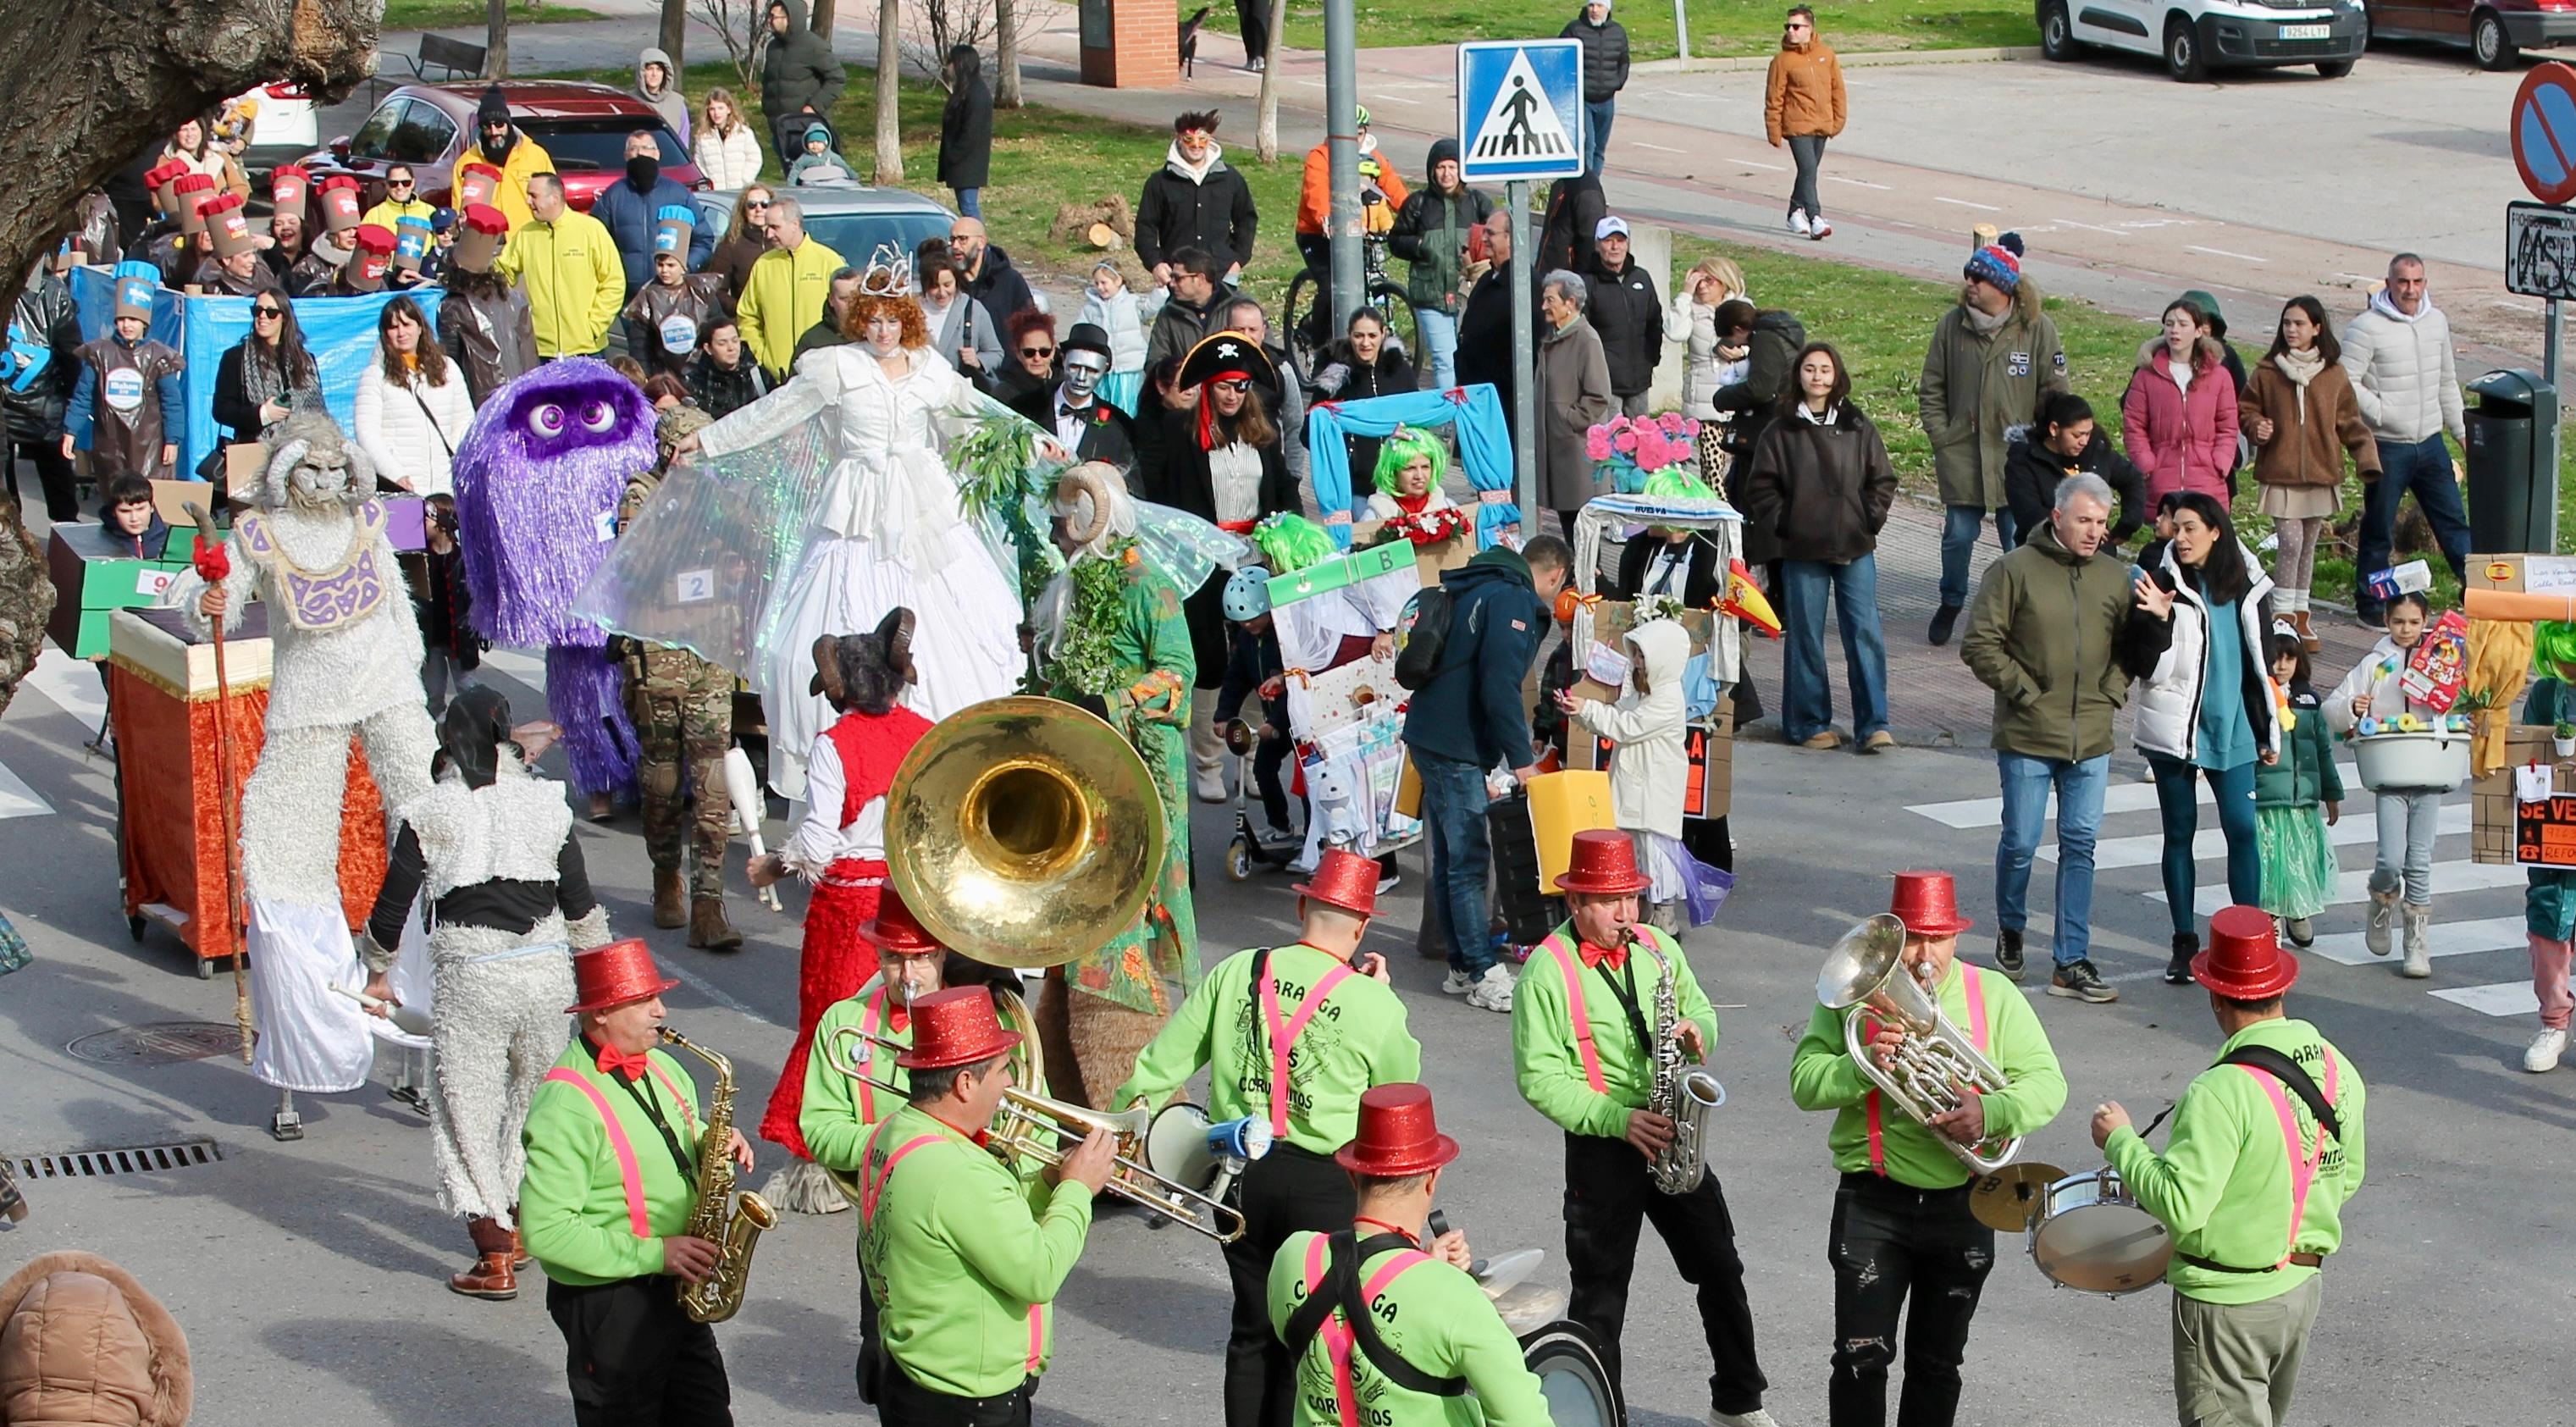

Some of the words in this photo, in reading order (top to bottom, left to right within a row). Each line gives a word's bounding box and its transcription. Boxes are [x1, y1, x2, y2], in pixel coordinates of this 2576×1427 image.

[2286, 26, 2308, 37] 9254
[2310, 26, 2328, 36] LYY
[1634, 506, 1667, 515] HUELVA
[1378, 550, 1394, 572] B
[153, 576, 169, 594] 9
[690, 577, 705, 597] 2
[2519, 802, 2546, 820] SE
